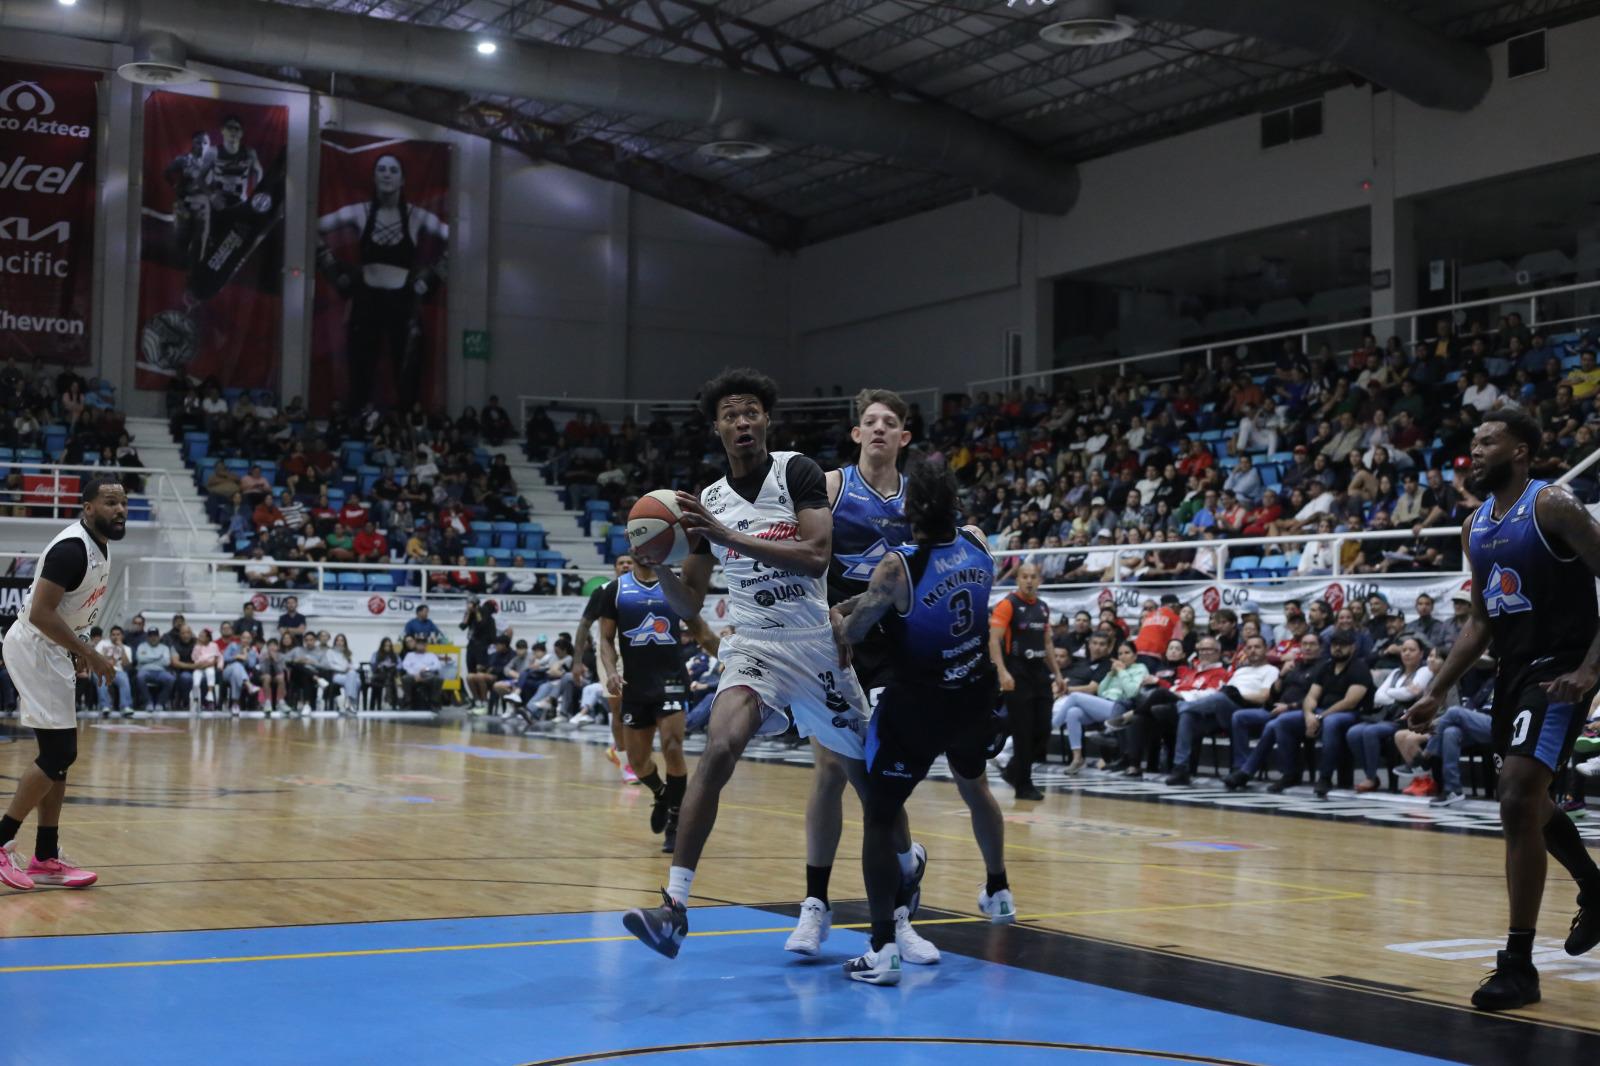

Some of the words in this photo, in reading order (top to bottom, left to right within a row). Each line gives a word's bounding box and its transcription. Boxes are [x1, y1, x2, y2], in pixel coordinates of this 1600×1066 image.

[23, 118, 91, 138] Azteca
[0, 156, 84, 195] lcel
[0, 251, 69, 277] cific
[0, 310, 85, 335] hevron
[740, 574, 770, 589] Banco
[773, 583, 806, 601] UAD
[501, 600, 527, 613] UAD
[948, 588, 974, 637] 3
